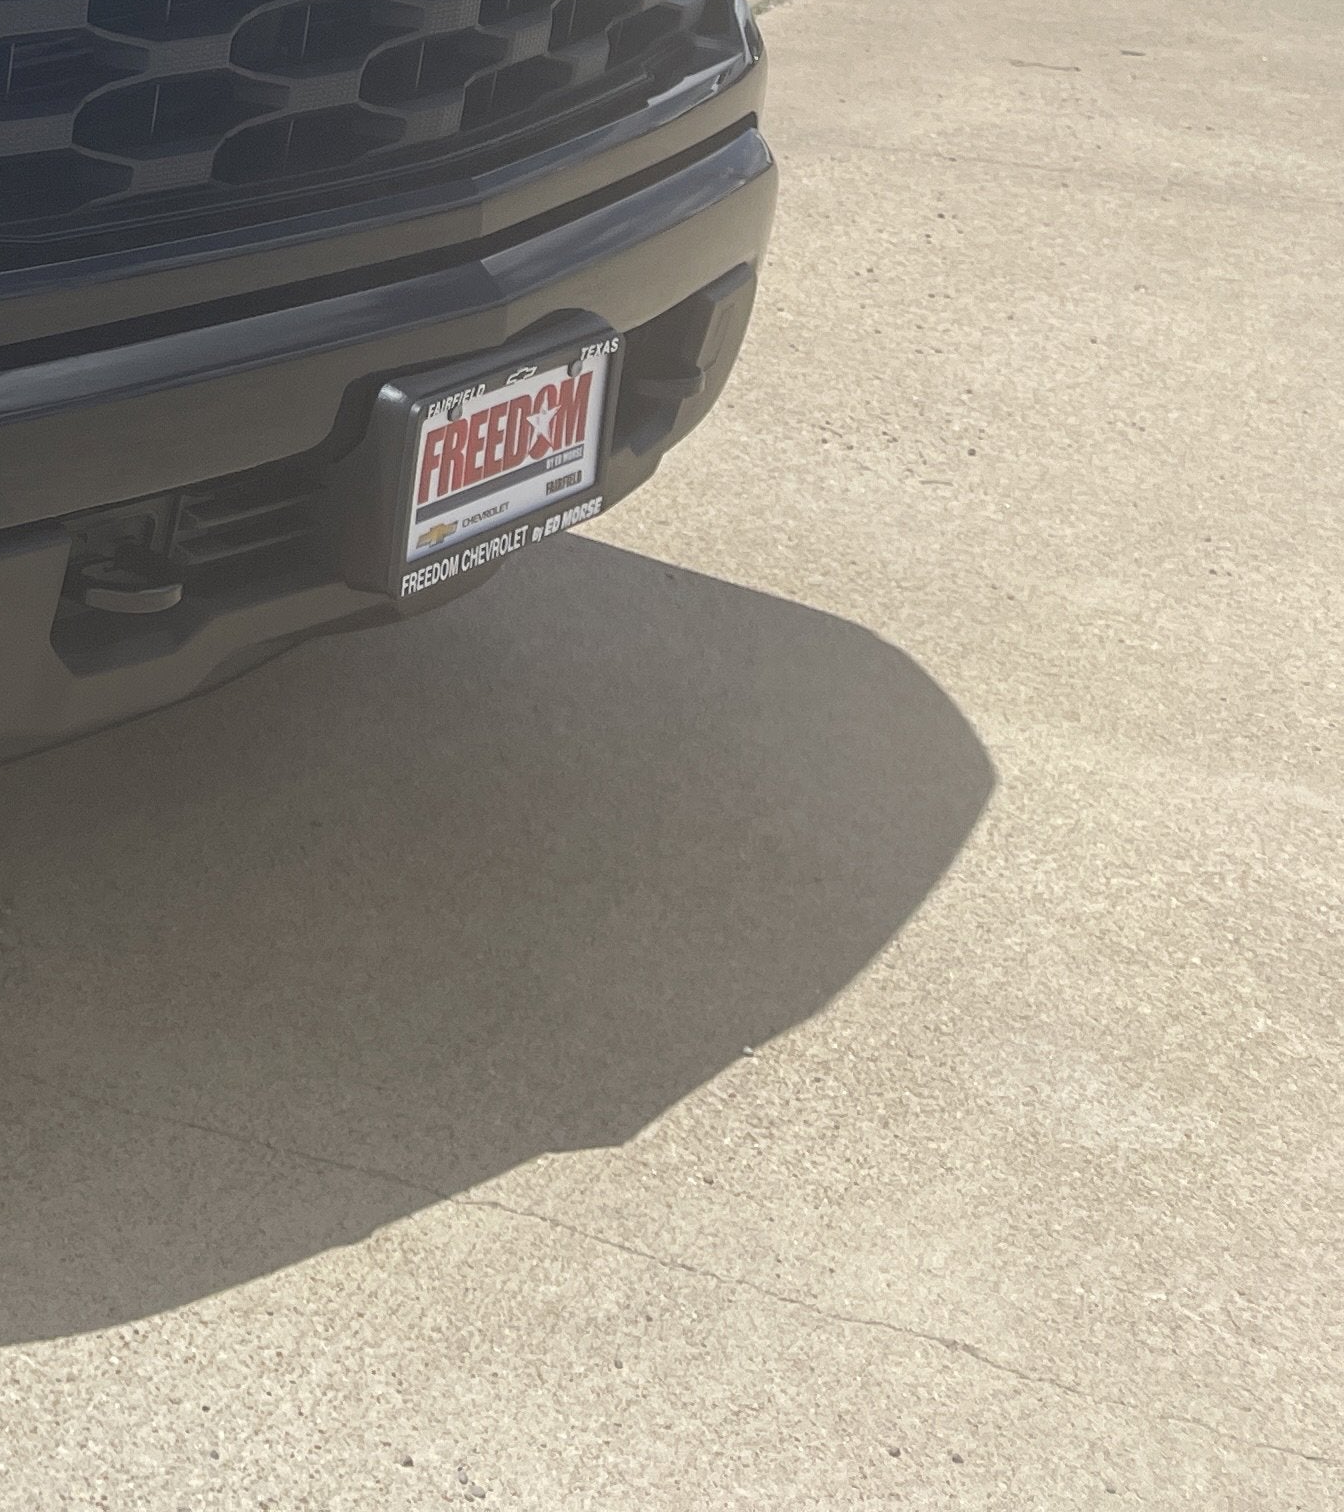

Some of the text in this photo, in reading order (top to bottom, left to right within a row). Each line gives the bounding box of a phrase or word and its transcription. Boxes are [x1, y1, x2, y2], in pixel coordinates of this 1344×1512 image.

[427, 337, 620, 419] FAIRFIELD TEXAS
[417, 370, 594, 506] FREEDOM
[401, 559, 459, 597] FREEDOM
[462, 524, 529, 572] CHEVROLET
[544, 514, 561, 537] ED
[561, 496, 603, 530] MORSE
[462, 501, 510, 529] CHEVROLET
